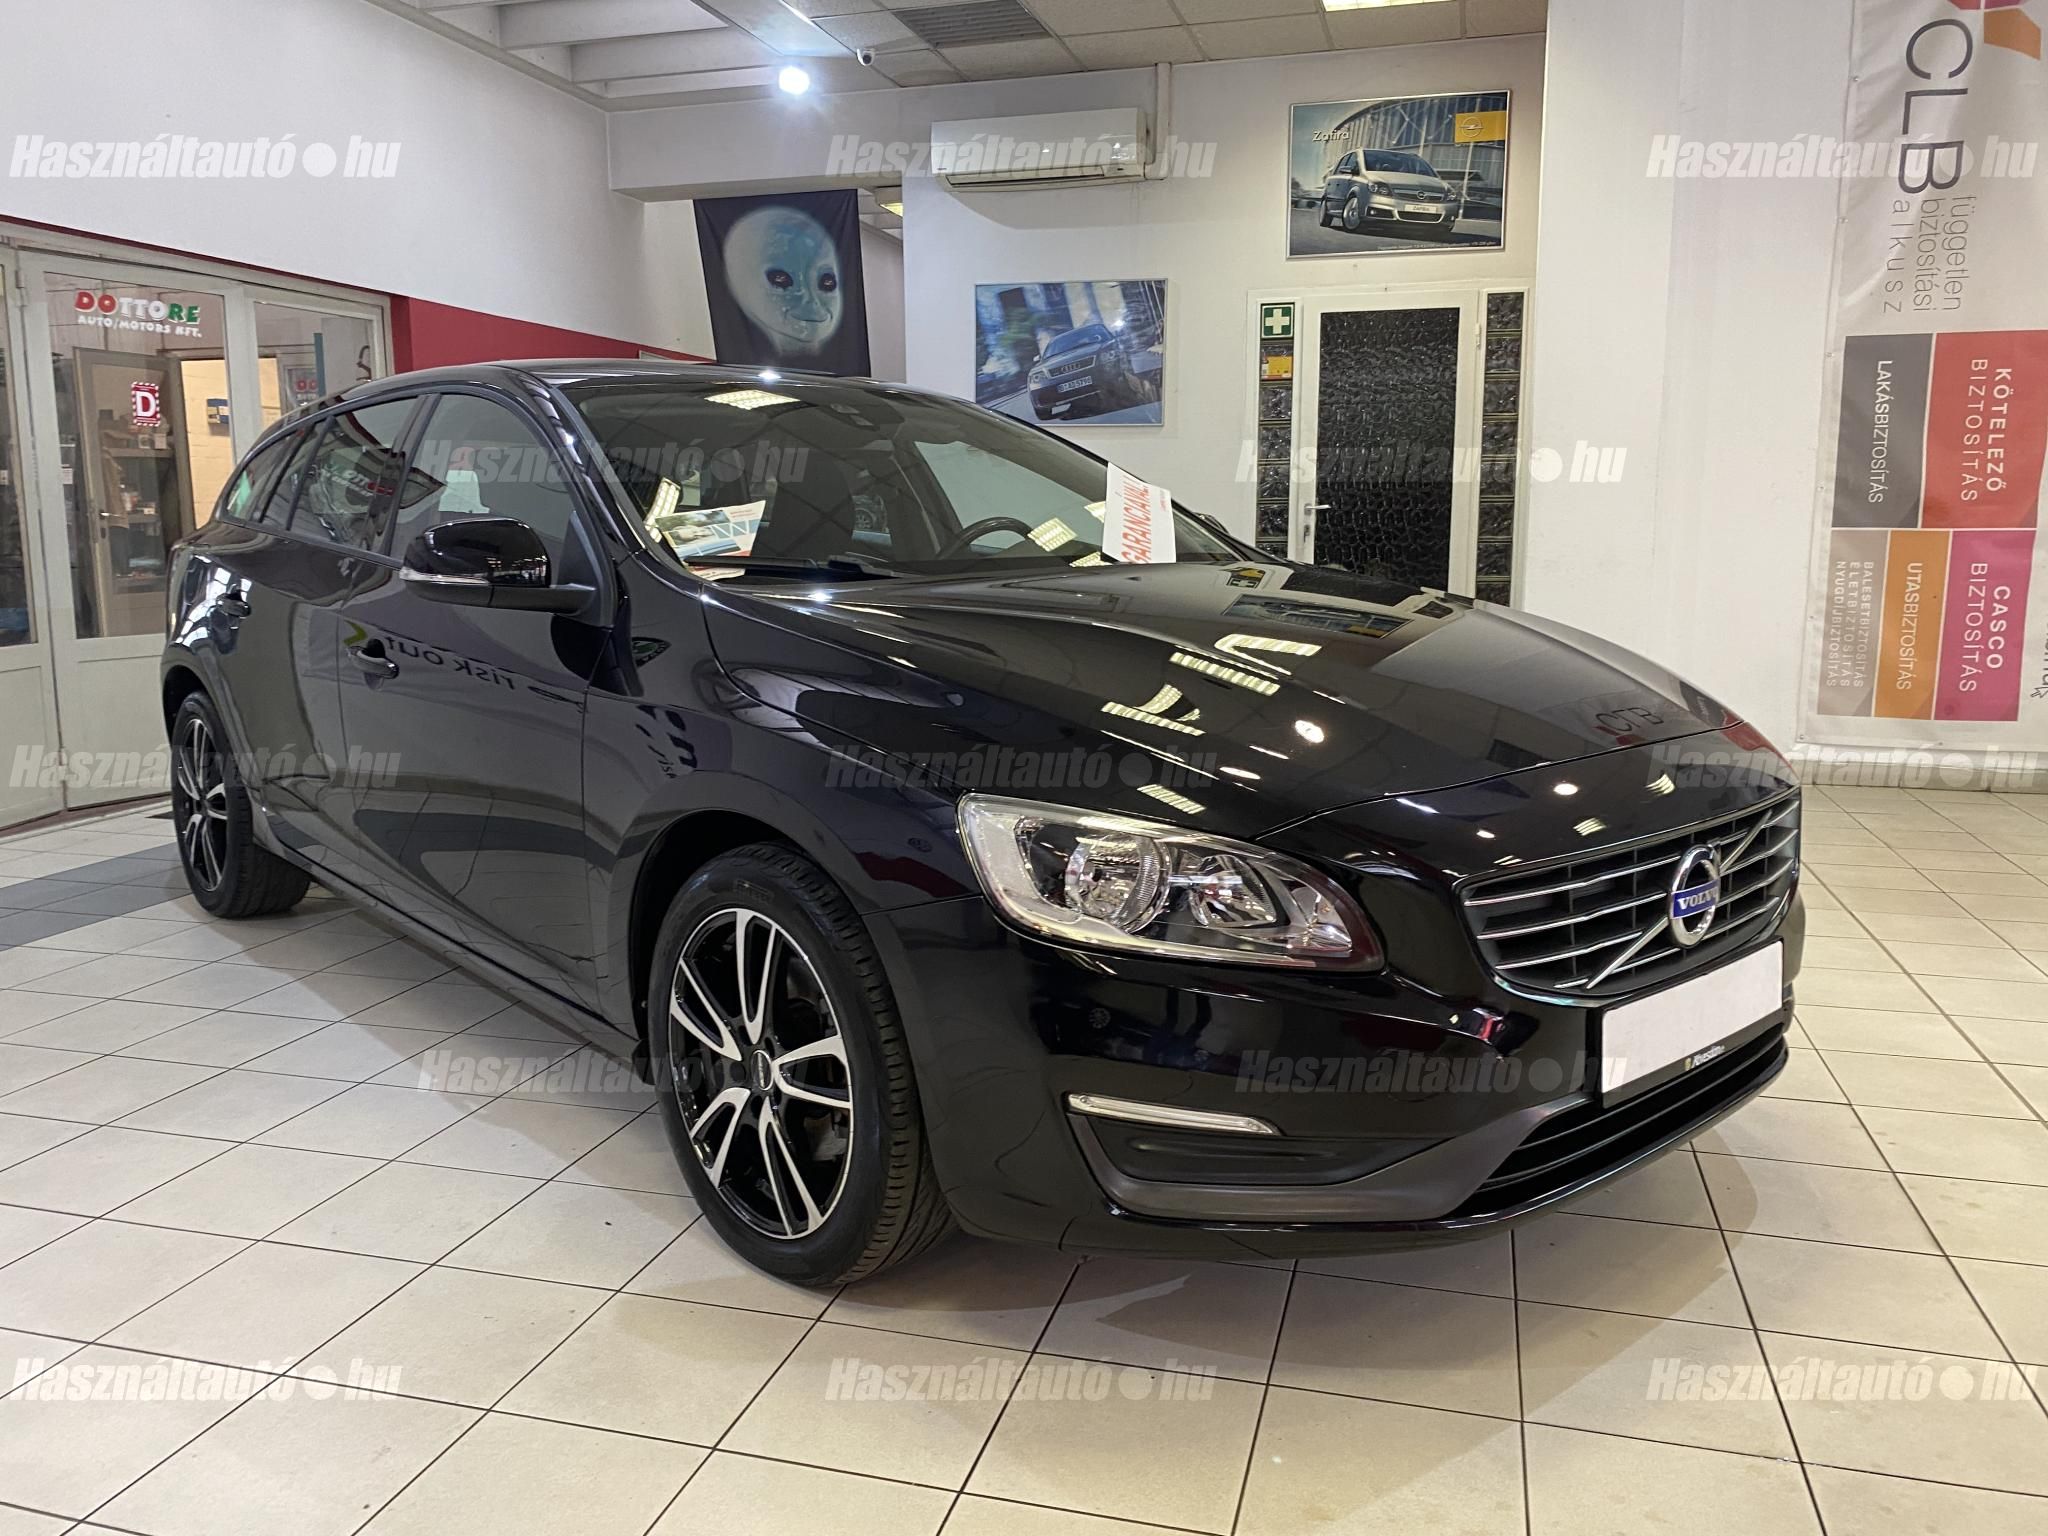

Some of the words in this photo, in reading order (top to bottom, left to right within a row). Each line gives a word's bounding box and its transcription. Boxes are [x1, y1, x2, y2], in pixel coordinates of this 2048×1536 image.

[1897, 18, 1973, 194] CLB
[74, 290, 200, 325] DOTTORE
[1883, 199, 1915, 313] alkusz
[1913, 197, 1946, 311] biztosítási
[1942, 196, 1977, 310] független
[136, 391, 157, 417] D
[1868, 360, 1895, 503] LAKÁSBIZTOSÍTÁS
[1961, 359, 1988, 501] BIZTOSÍTÁS
[1986, 368, 2014, 491] KÖTELEZŐ
[1840, 561, 1861, 687] ÉLETBIZTOSÍTÁS
[1853, 561, 1875, 688] BALESETBIZTOSÍTÁS
[1896, 562, 1923, 690] UTASBIZTOSÍTÁS
[1959, 563, 1988, 692] BIZTOSÍTÁS
[1987, 585, 2011, 669] CASCO
